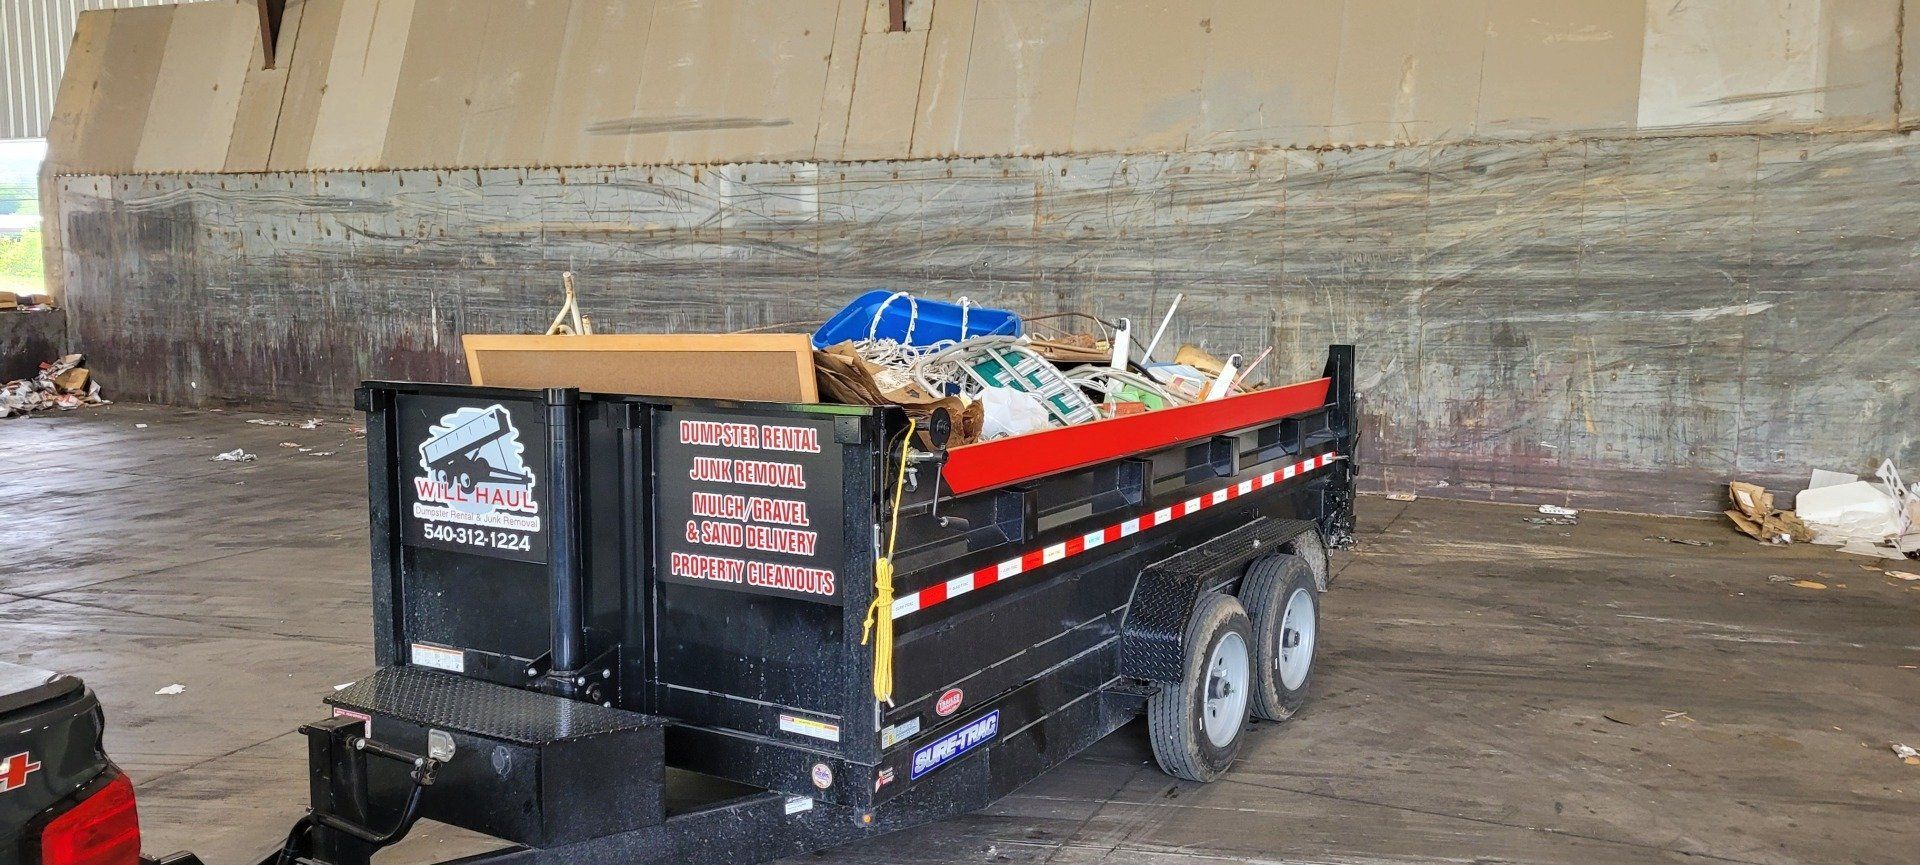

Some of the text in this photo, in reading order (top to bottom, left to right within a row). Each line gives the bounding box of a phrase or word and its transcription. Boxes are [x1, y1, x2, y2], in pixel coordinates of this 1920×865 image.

[680, 420, 820, 453] DUMPSTER RENTAL
[690, 457, 806, 489] JUNK REMOVAL
[417, 480, 535, 509] WILL HAUL
[693, 492, 809, 526] MULCH/GRAVEL
[415, 505, 538, 528] Dumpster Rental & Junk Removal
[424, 523, 531, 552] 540-312-1224
[686, 520, 817, 556] & SAND DELIVERY
[671, 552, 835, 596] PROPERTY CLEANOUTS
[913, 714, 997, 774] SURE-TRAC
